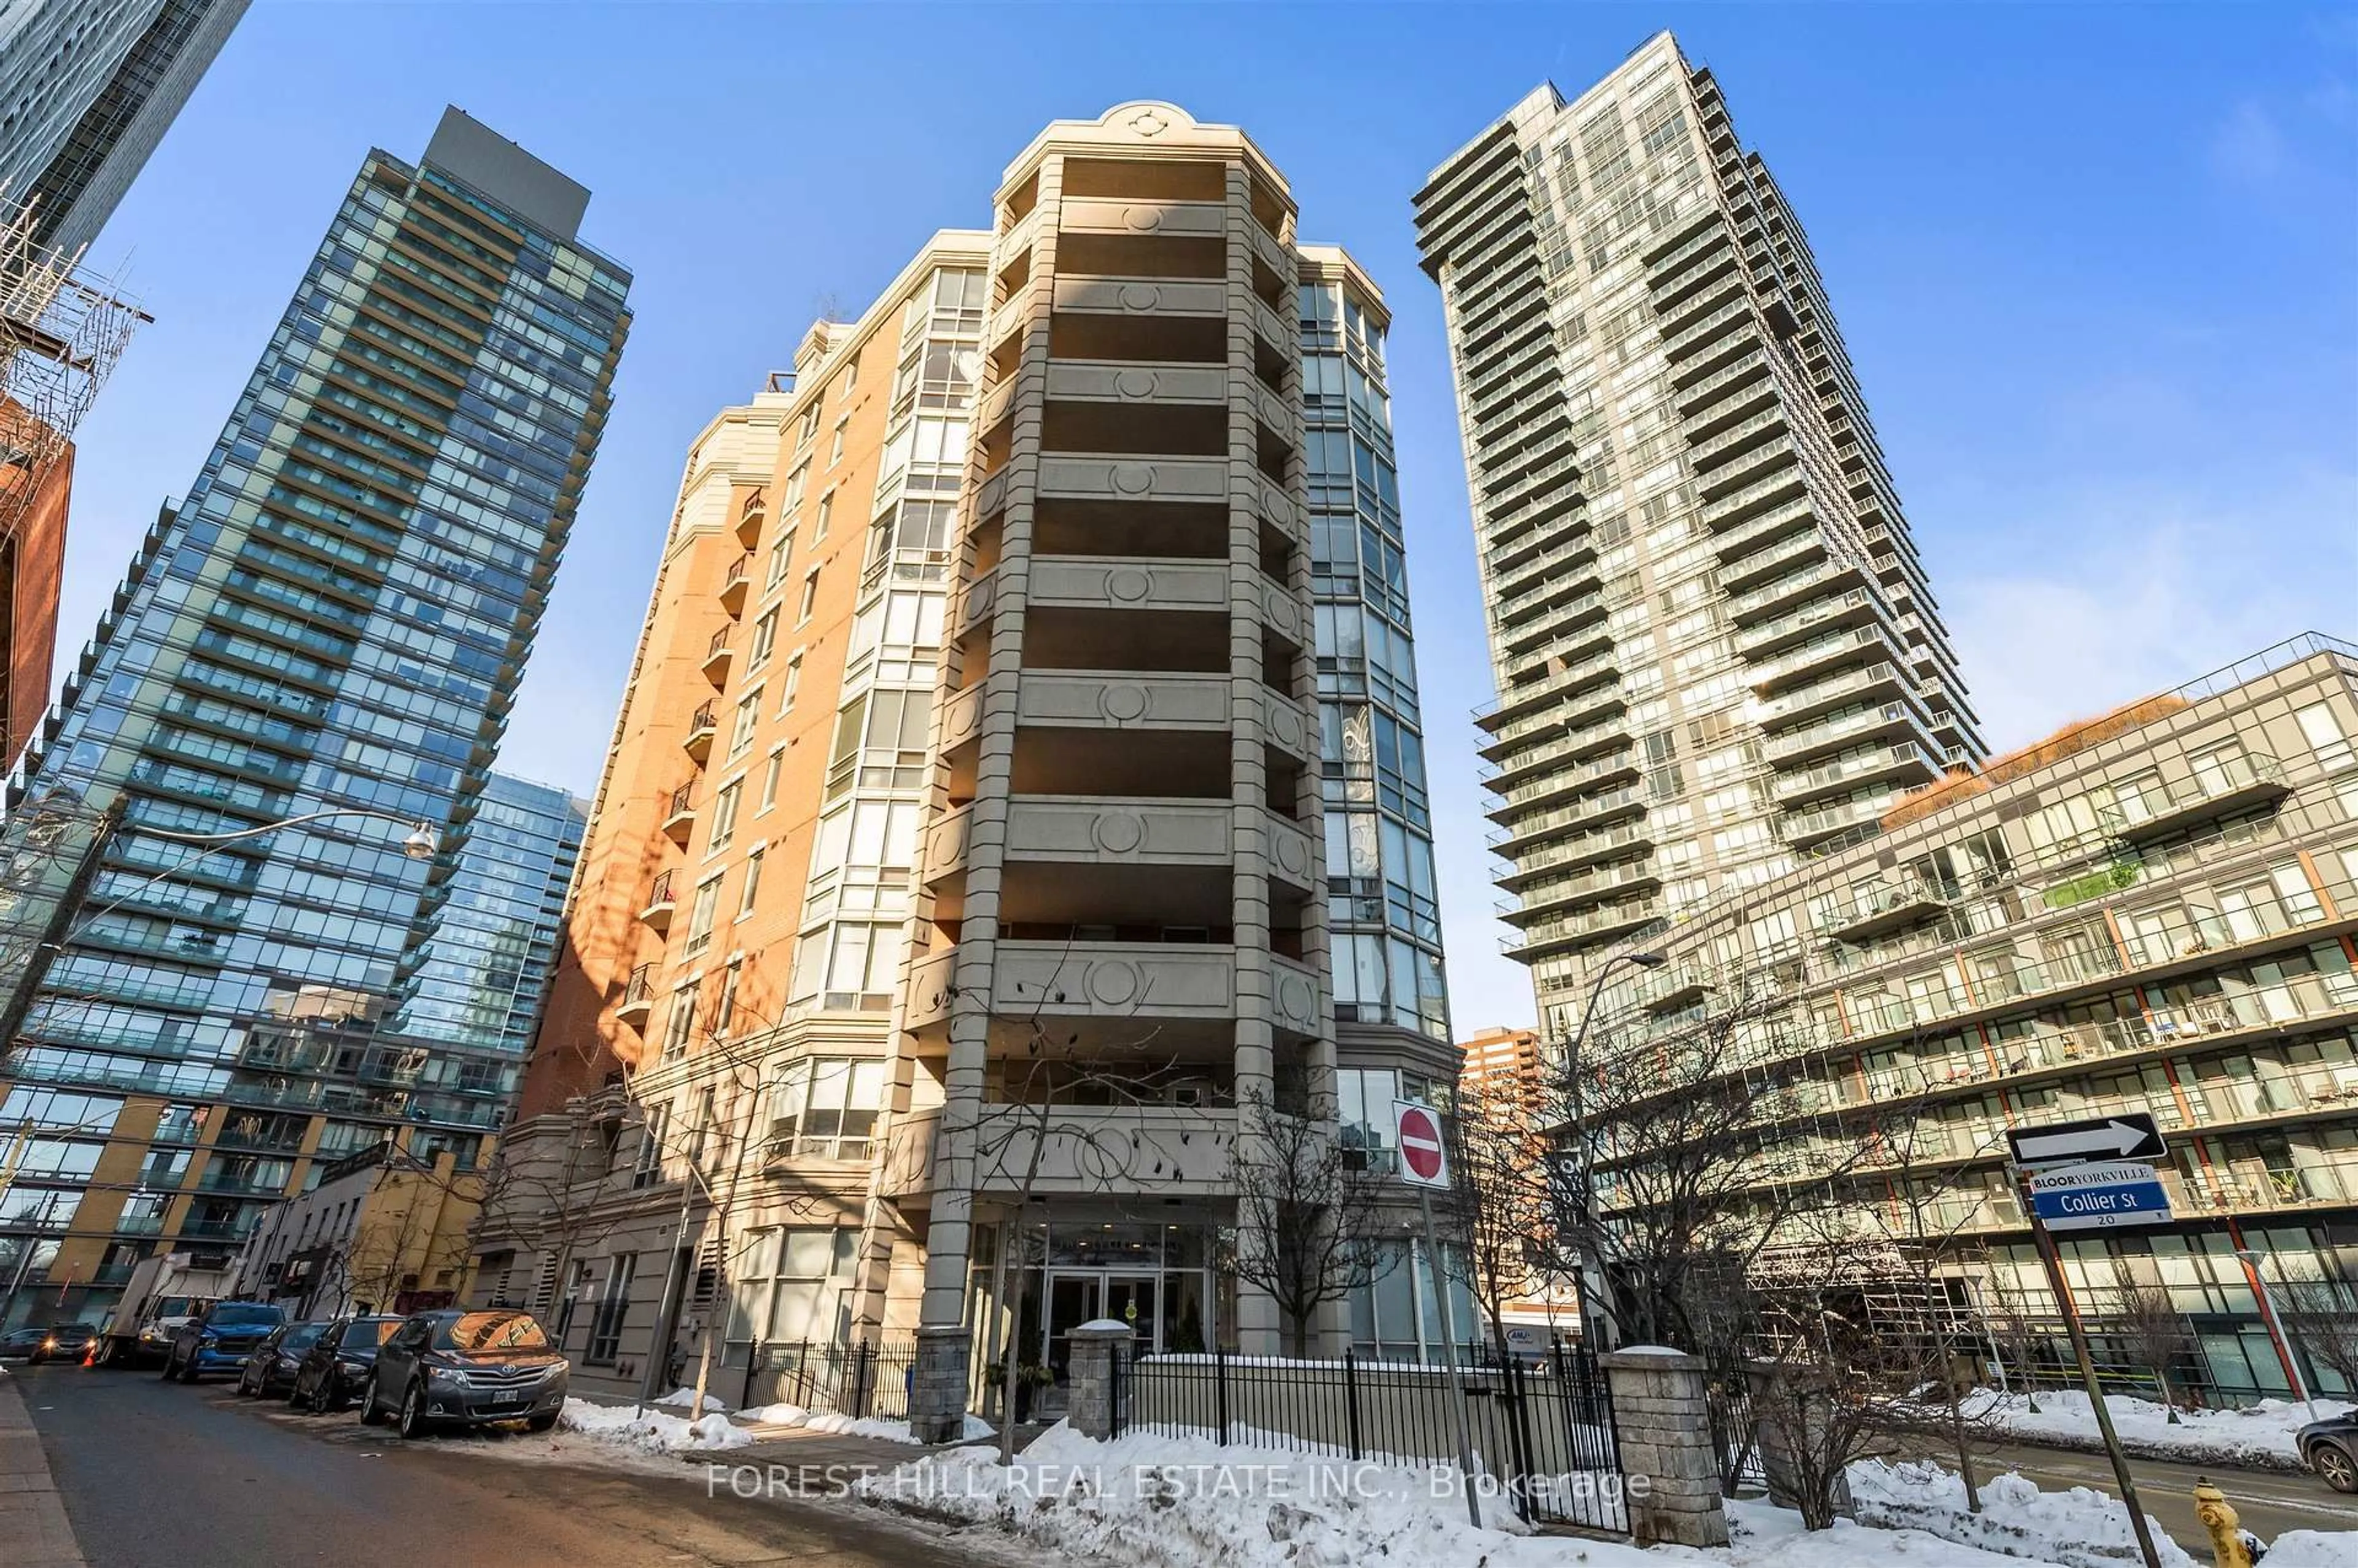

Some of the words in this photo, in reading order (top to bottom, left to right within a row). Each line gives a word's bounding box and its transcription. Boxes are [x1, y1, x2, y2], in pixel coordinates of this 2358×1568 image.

[2034, 1168, 2149, 1189] BLOORYORKVILLE
[2060, 1193, 2115, 1213] Collier
[2122, 1192, 2138, 1208] St
[2098, 1215, 2115, 1225] 20
